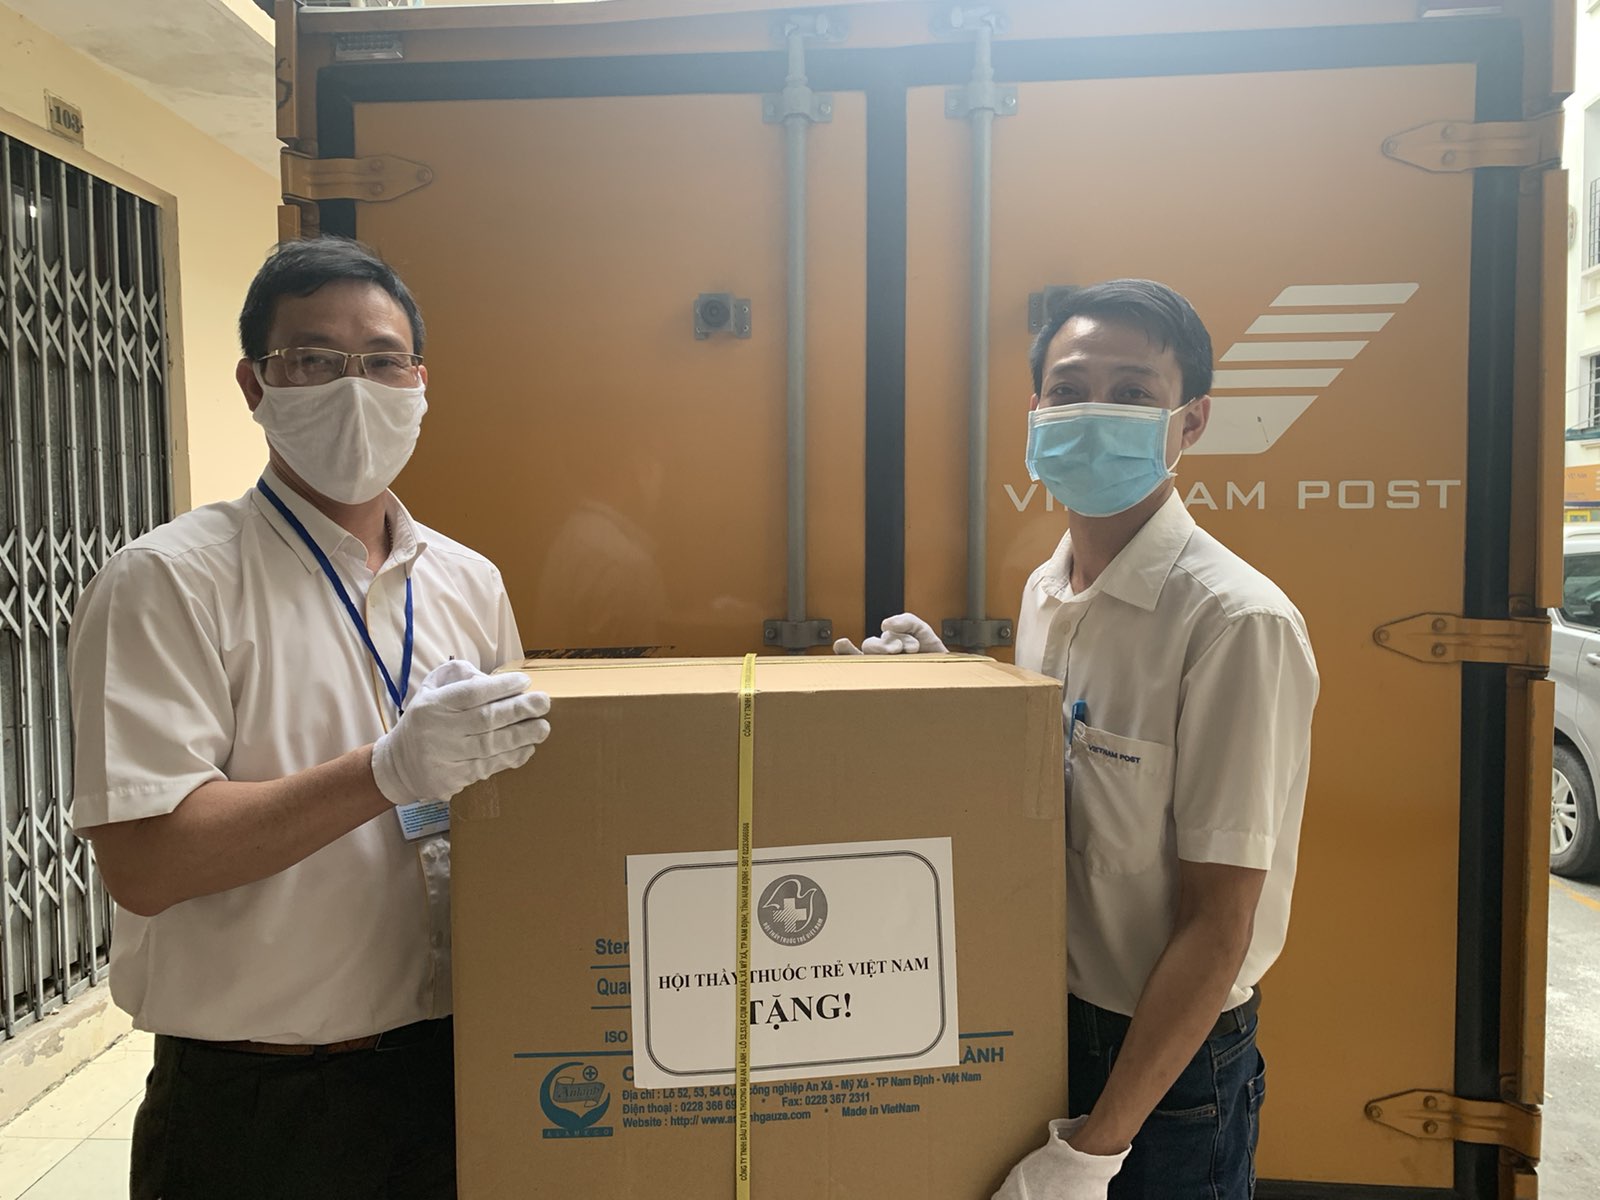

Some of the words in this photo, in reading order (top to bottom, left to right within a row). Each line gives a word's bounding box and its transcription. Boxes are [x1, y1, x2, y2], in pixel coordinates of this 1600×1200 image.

[1003, 481, 1265, 512] VIAM
[1298, 480, 1461, 510] POST
[1088, 744, 1118, 759] VIETNAM
[1119, 753, 1141, 764] POST
[659, 973, 690, 992] HỘI
[750, 963, 807, 984] THUỐC
[811, 960, 844, 979] TRẺ
[848, 959, 888, 978] VIỆT
[891, 957, 929, 973] NAM
[750, 992, 852, 1031] TẶNG!
[604, 1030, 628, 1043] ISO
[960, 1045, 1004, 1065] ÀNH
[622, 1090, 638, 1102] Địa
[677, 1088, 691, 1099] 52,
[693, 1086, 707, 1098] 53,
[710, 1086, 721, 1097] 54
[722, 1086, 736, 1098] Cụ
[772, 1082, 804, 1096] nghiệp
[805, 1081, 819, 1092] An
[821, 1080, 833, 1092] Xá
[840, 1079, 855, 1092] Mỹ
[856, 1078, 869, 1089] Xá
[876, 1077, 889, 1088] TP
[890, 1076, 911, 1087] Nam
[913, 1074, 935, 1088] Định
[942, 1072, 960, 1086] Việt
[961, 1072, 982, 1082] Nam
[622, 1103, 645, 1116] Điện
[647, 1102, 672, 1115] thoại
[680, 1102, 704, 1112] 0228
[781, 1096, 802, 1107] Fax:
[805, 1094, 828, 1106] 0228
[848, 1092, 870, 1103] 2311
[842, 1106, 868, 1117] Made
[869, 1104, 879, 1115] in
[880, 1102, 920, 1114] VietNam
[622, 1116, 662, 1128] Website
